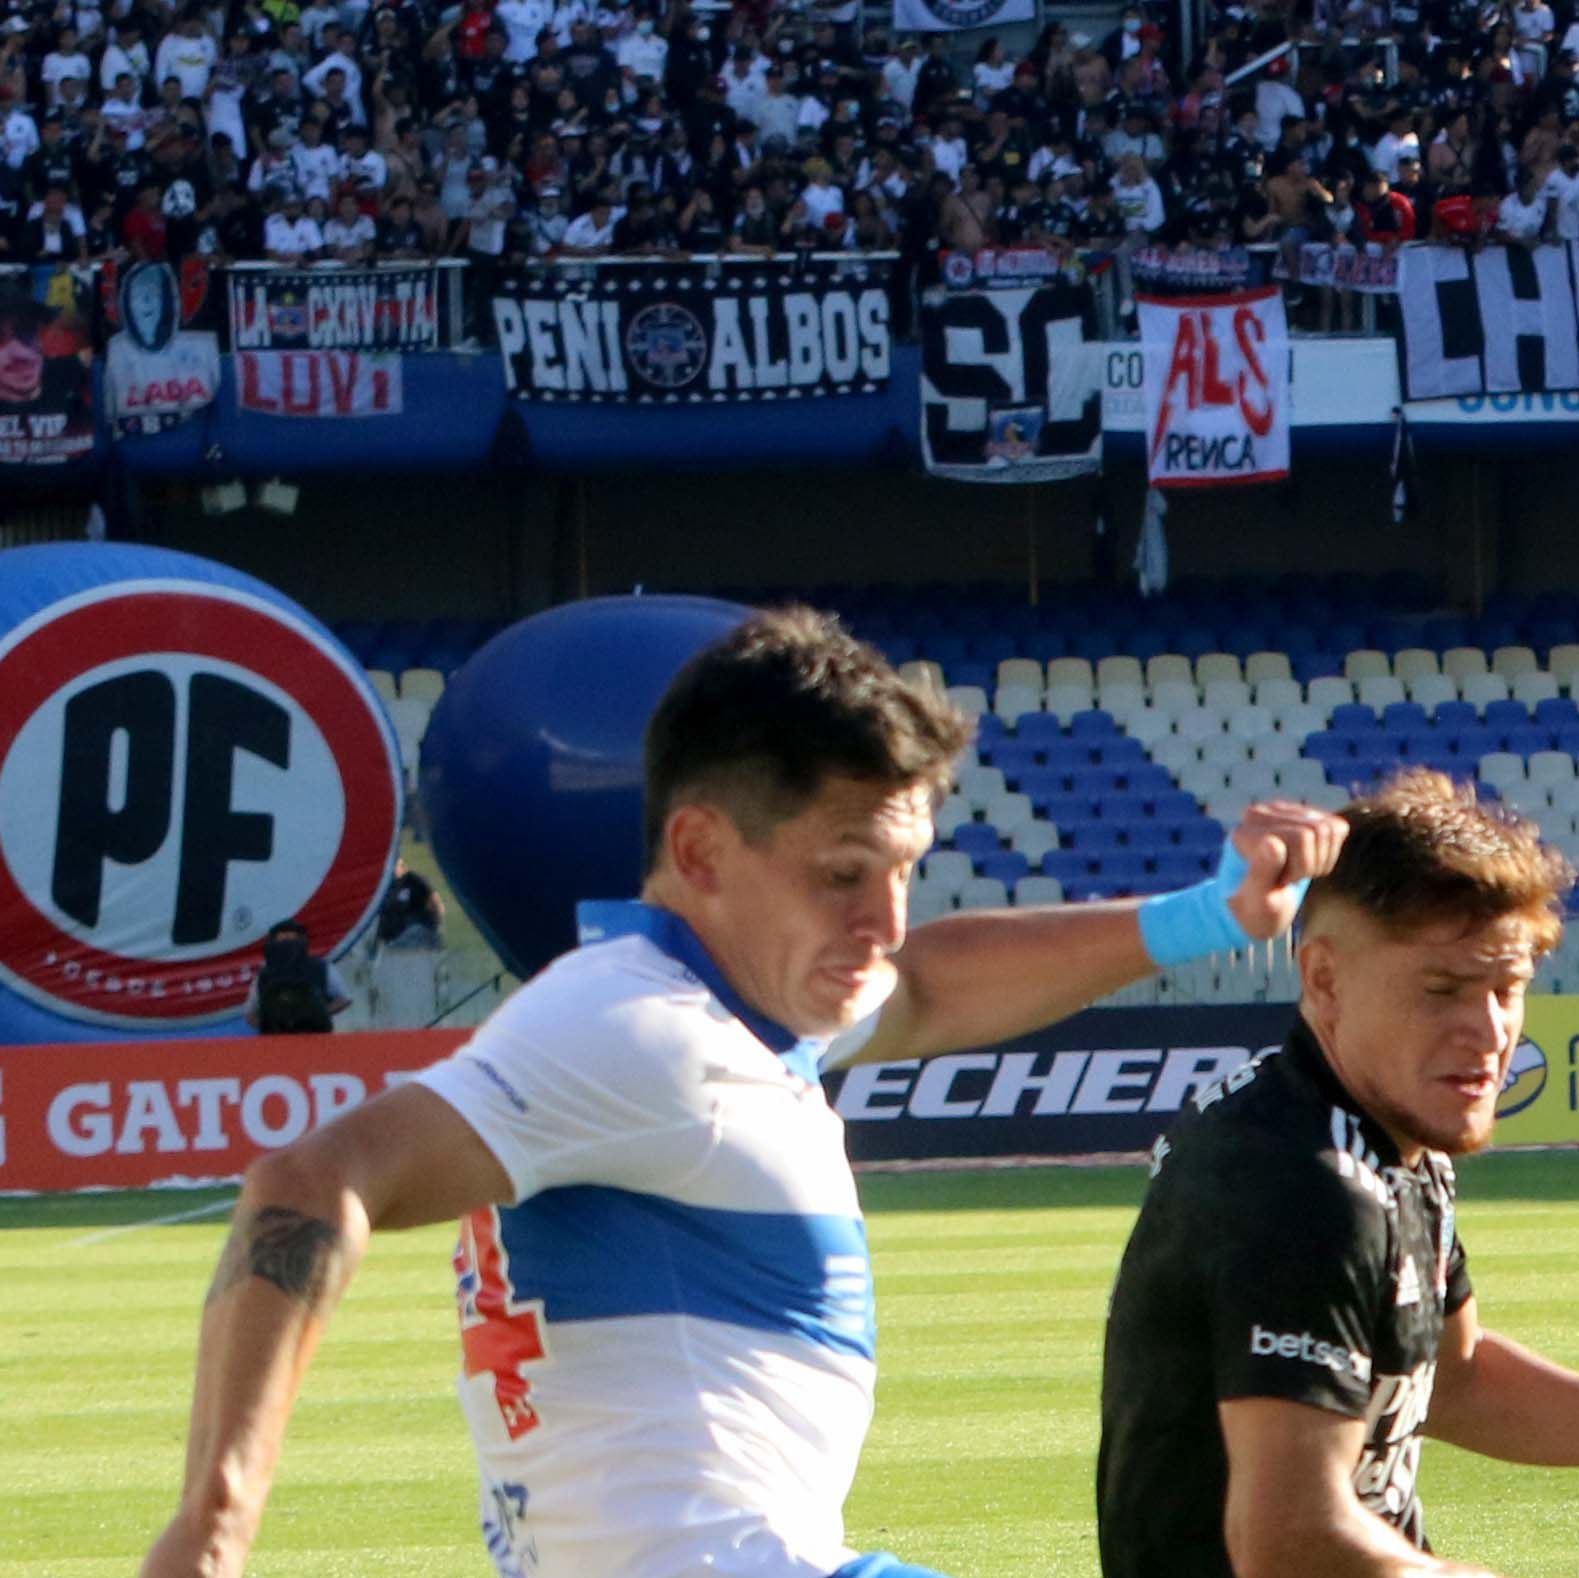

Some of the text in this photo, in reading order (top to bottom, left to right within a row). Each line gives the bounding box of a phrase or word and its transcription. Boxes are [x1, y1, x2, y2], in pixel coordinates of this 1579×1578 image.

[495, 291, 890, 392] PEÑI ALBOS
[51, 670, 291, 947] PF
[833, 1045, 1285, 1121] ECHER
